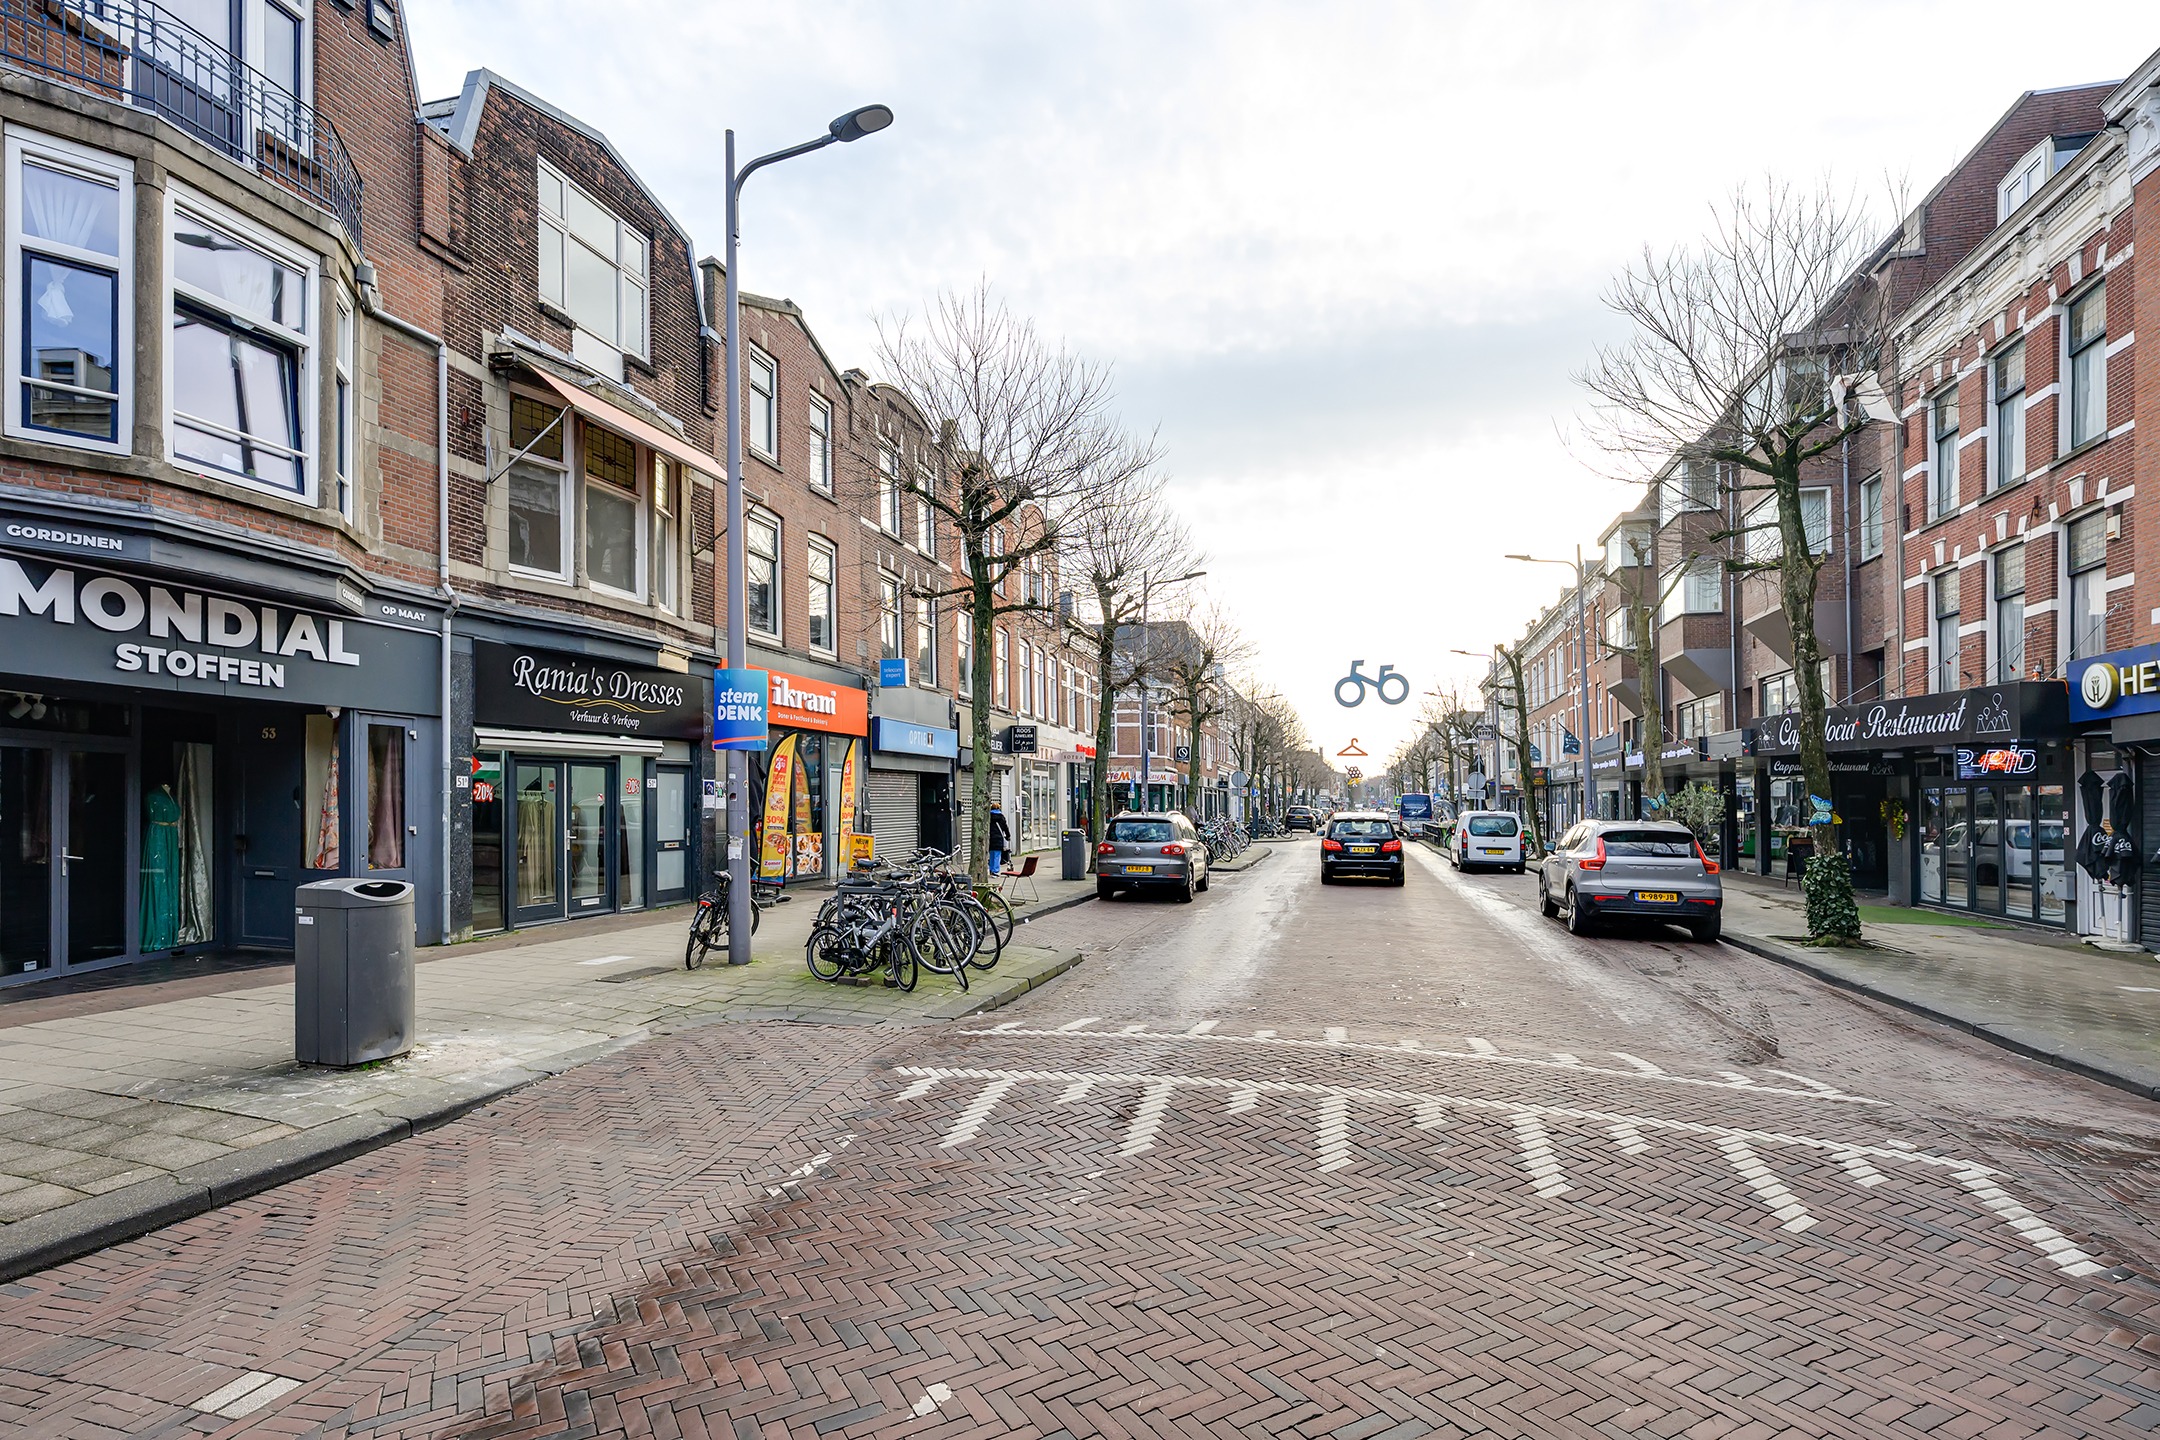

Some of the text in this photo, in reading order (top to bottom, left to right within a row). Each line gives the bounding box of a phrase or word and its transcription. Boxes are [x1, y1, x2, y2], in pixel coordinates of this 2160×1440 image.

[6, 523, 123, 551] GORDIJNEN
[0, 557, 360, 667] MONDIAL
[382, 605, 426, 622] OP MAAT
[115, 642, 285, 689] STOFFEN
[512, 655, 684, 707] Rania's Dresses
[2120, 660, 2160, 697] HE
[719, 687, 759, 704] stem
[771, 675, 838, 716] ikram
[569, 709, 640, 730] Verhuur & Verkoop
[717, 704, 763, 722] DENK
[261, 727, 277, 740] 53
[1778, 697, 1968, 751] Capocia Restaurant
[473, 783, 494, 801] -20%
[766, 815, 785, 824] 30%
[1640, 893, 1675, 901] R-989-JB
